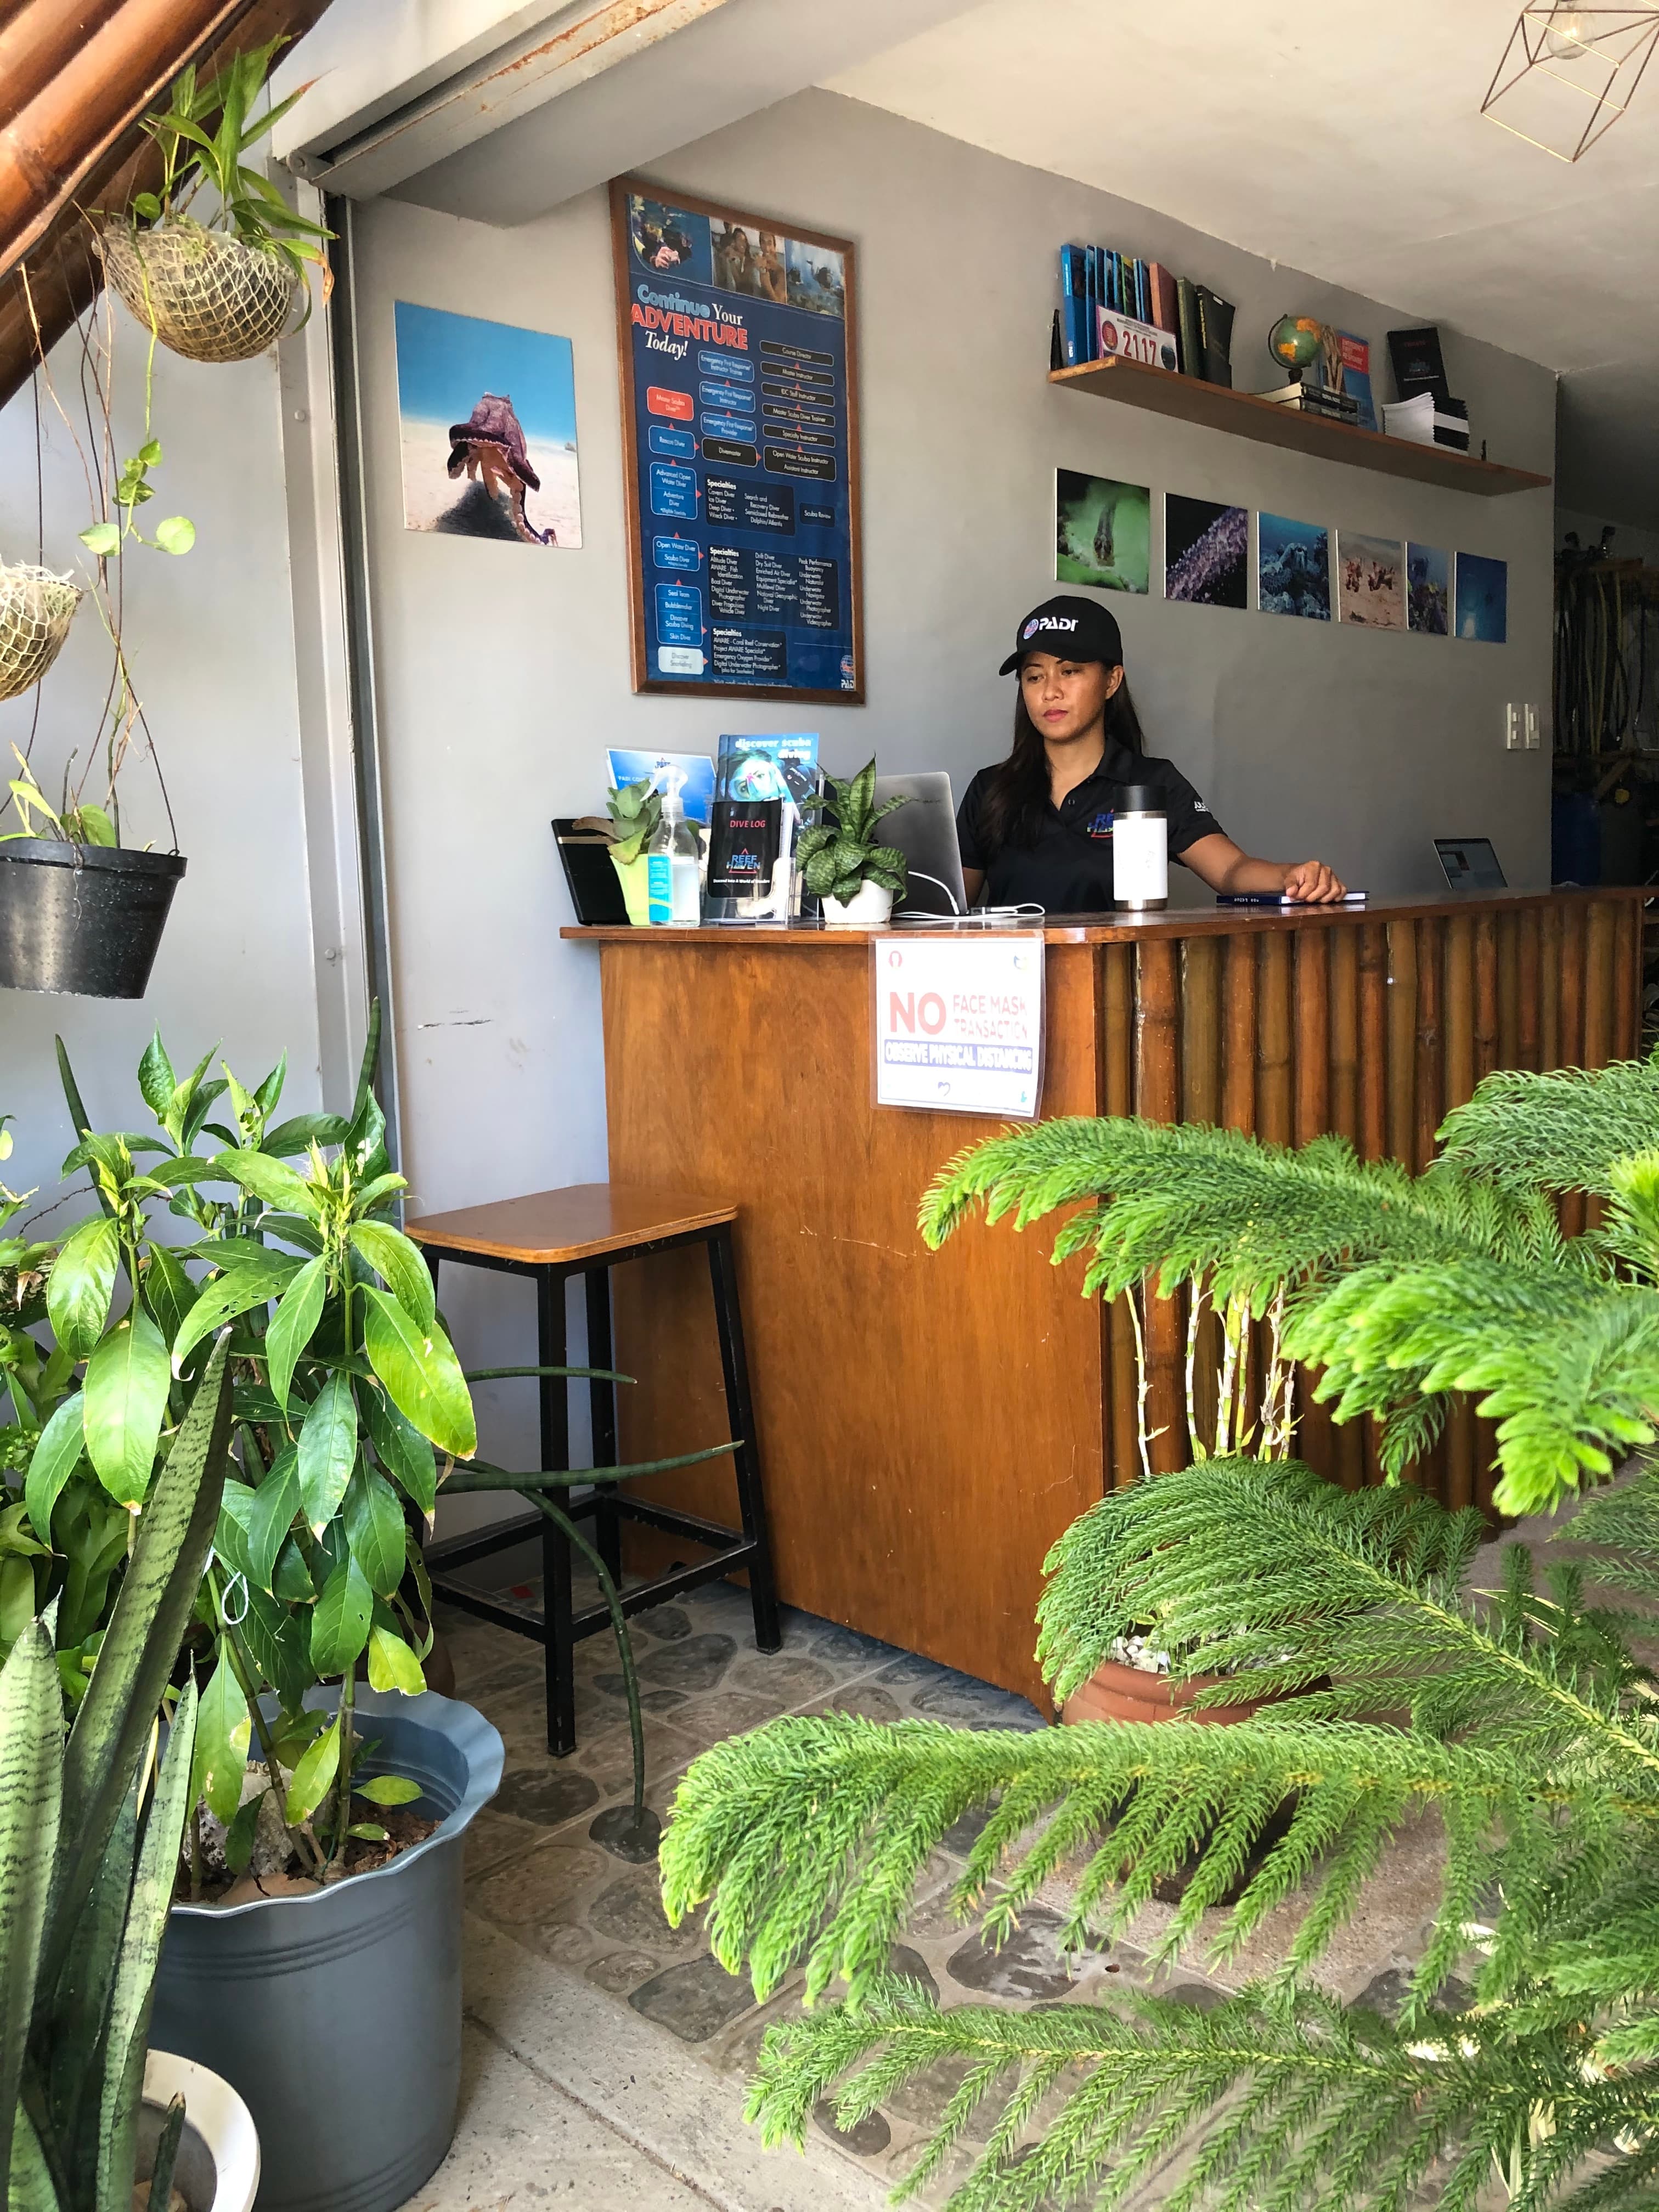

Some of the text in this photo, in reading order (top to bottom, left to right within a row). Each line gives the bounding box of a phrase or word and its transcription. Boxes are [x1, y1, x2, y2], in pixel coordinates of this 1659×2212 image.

[637, 284, 743, 325] Continue Your
[631, 303, 748, 351] ADVENTURE
[645, 330, 688, 360] Today!
[1123, 331, 1156, 365] 2117
[707, 479, 736, 490] Specialties
[710, 547, 739, 557] Specialties
[1039, 617, 1079, 631] PADI
[713, 628, 742, 637] Specialties
[841, 679, 854, 689] PAD
[735, 737, 811, 748] discover scuba
[777, 748, 811, 760] diving
[726, 861, 760, 870] HAVEN
[889, 991, 1028, 1035] NO FACE MASK
[954, 1018, 1028, 1040] TRANSACTION
[885, 1041, 1032, 1071] OBSERVE PHYSICAL DISTANCING
